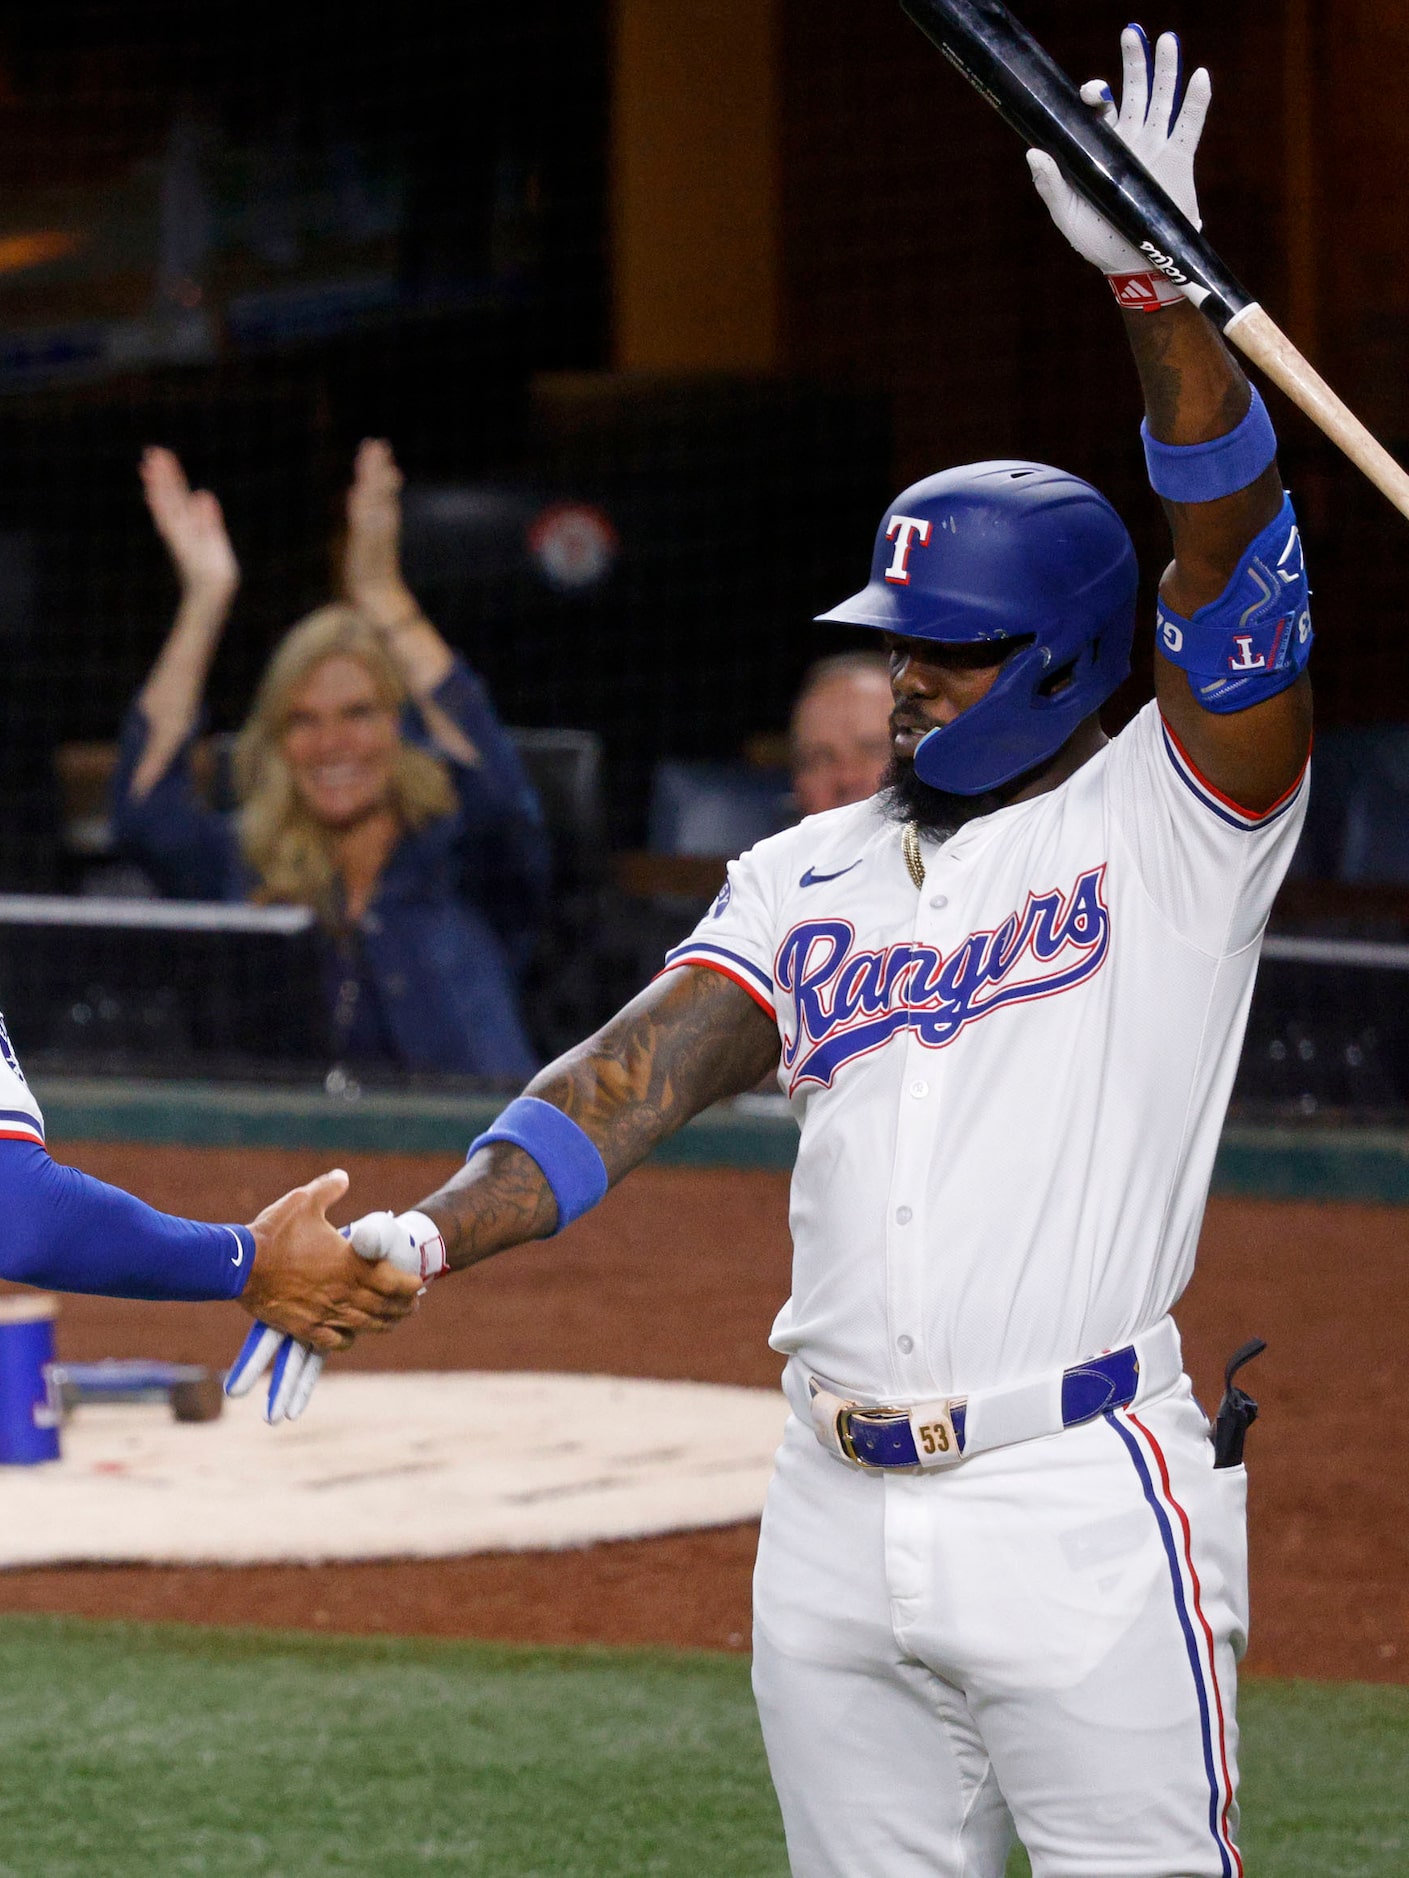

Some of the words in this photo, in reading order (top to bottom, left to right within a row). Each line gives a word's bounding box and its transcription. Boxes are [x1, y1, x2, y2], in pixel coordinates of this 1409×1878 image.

[884, 515, 934, 586] T
[1227, 635, 1265, 670] T
[774, 862, 1111, 1092] Rangers
[919, 1423, 950, 1455] 53
